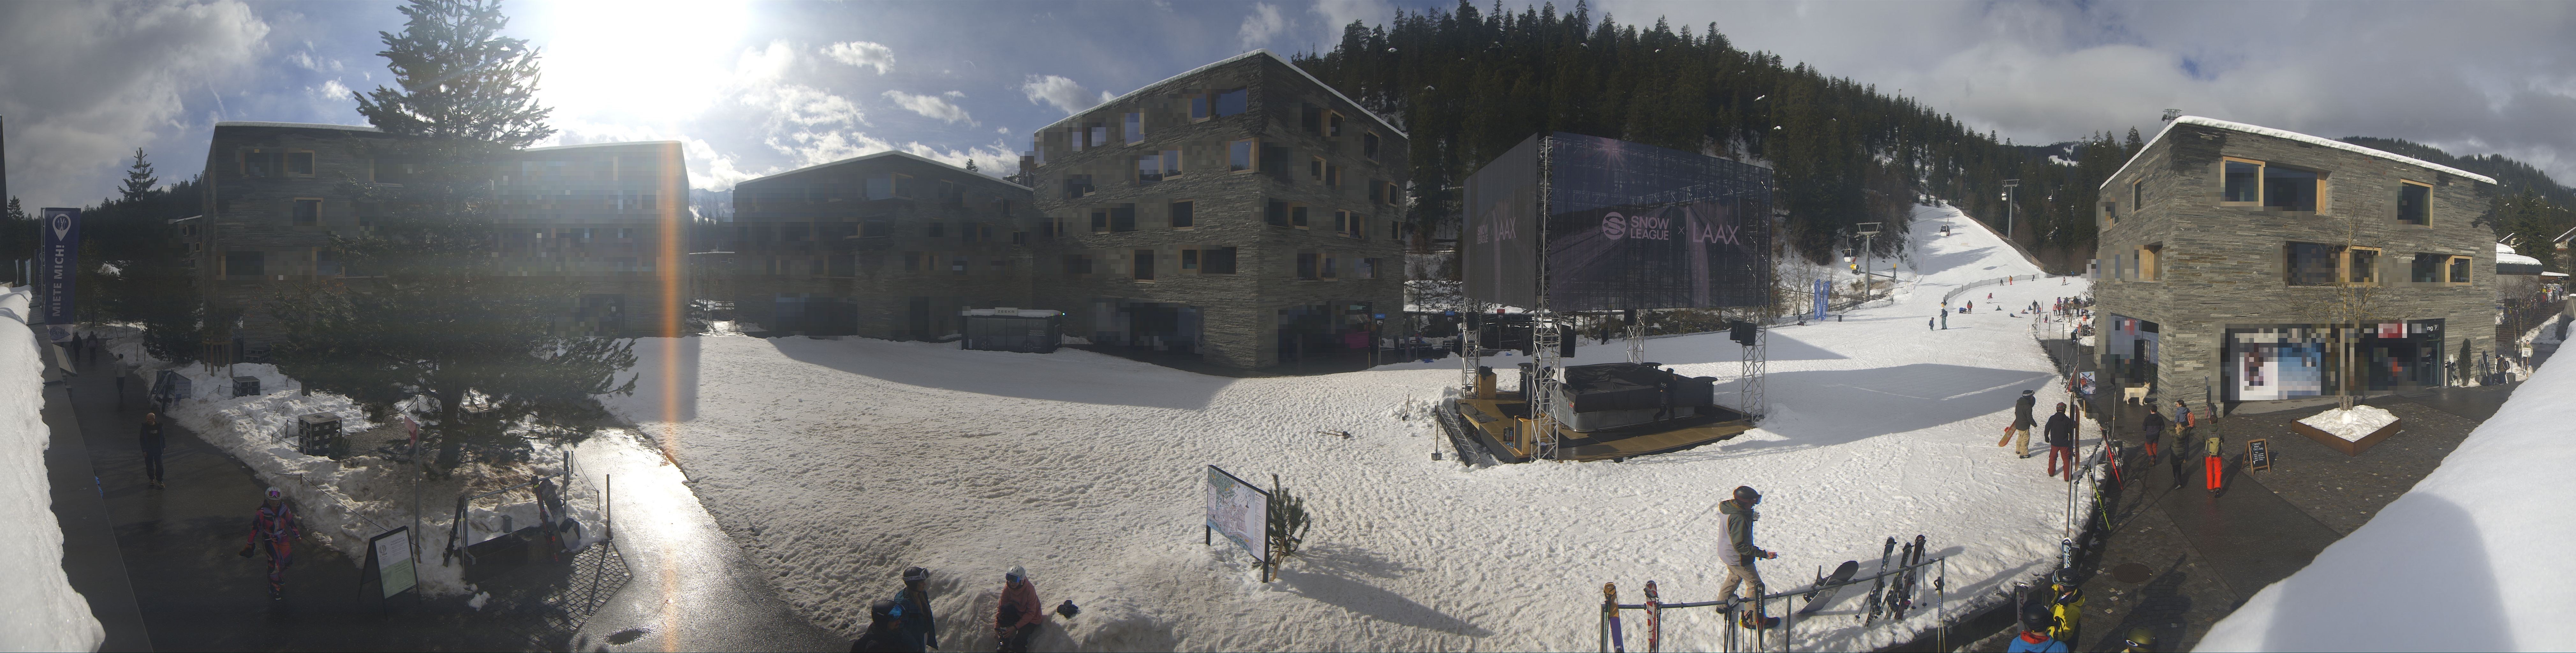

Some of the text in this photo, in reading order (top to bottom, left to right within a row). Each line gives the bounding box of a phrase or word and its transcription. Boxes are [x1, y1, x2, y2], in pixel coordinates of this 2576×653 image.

[1477, 224, 1489, 236] SNOW
[1496, 217, 1516, 241] LAAX
[1630, 216, 1669, 230] SNOW
[1477, 234, 1488, 244] LEAGUE
[1630, 228, 1669, 240] LEAGUE
[1693, 222, 1739, 245] LAAX
[54, 245, 65, 279] MICH!
[53, 283, 62, 317] MIETE
